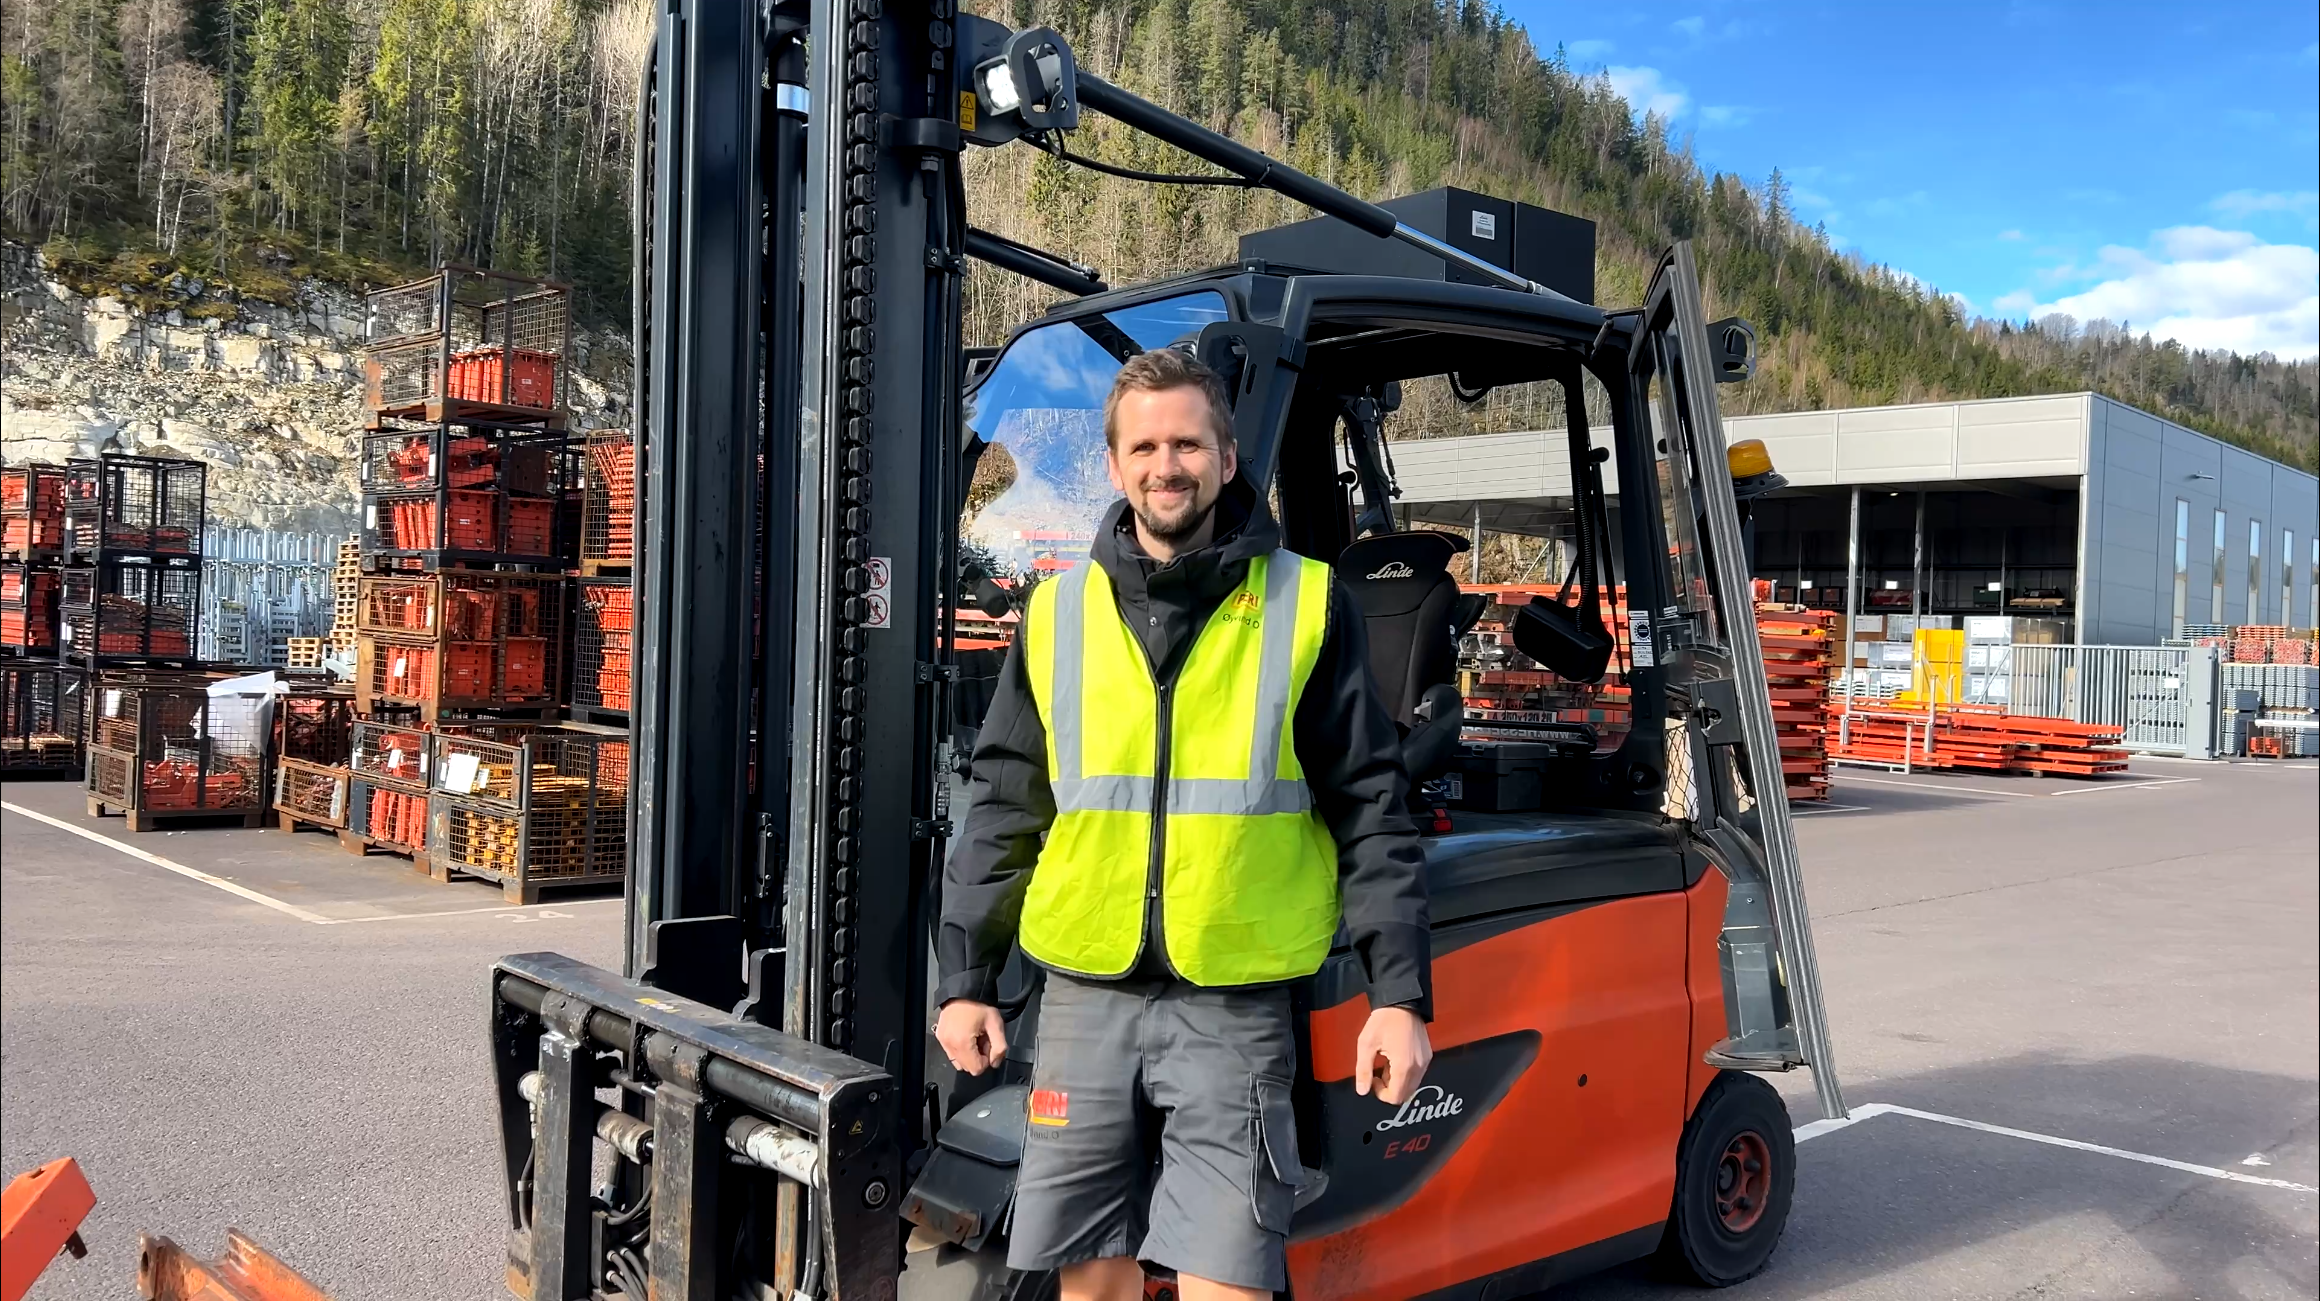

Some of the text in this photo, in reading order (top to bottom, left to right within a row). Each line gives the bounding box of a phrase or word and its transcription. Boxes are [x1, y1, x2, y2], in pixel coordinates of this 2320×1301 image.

[1366, 561, 1414, 580] Linde
[494, 910, 575, 923] 24
[1376, 1085, 1463, 1131] Linde
[1383, 1133, 1431, 1159] E 40
